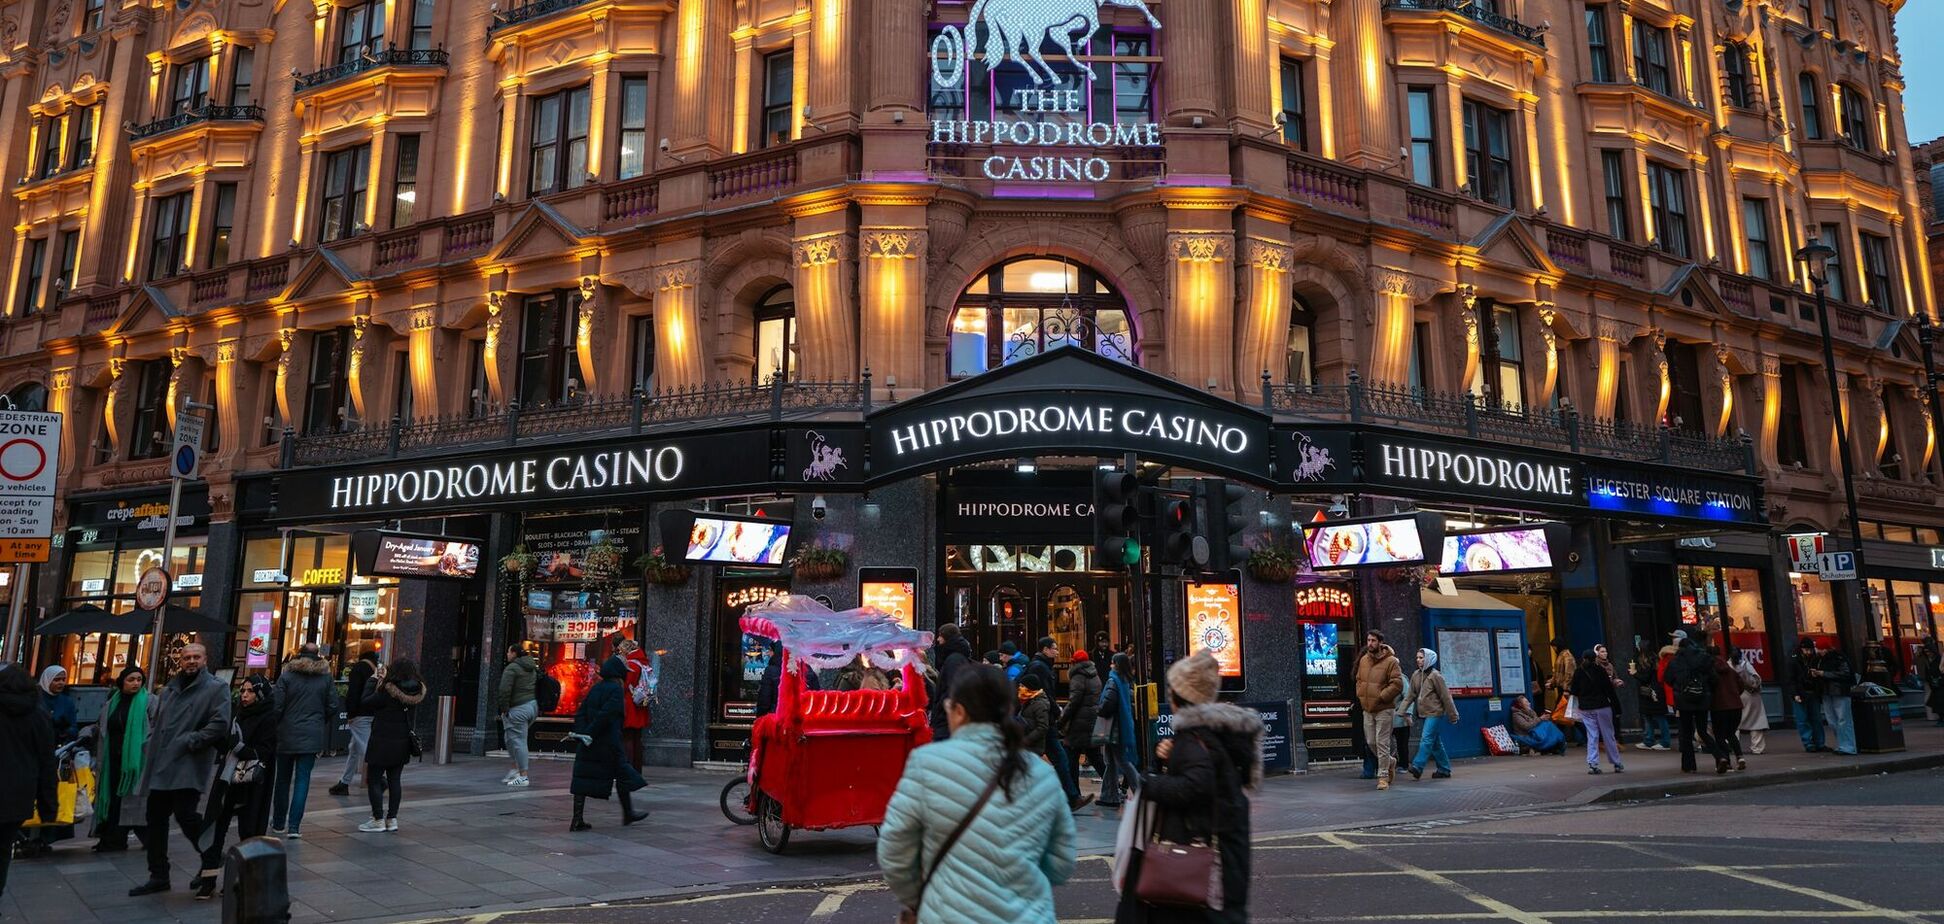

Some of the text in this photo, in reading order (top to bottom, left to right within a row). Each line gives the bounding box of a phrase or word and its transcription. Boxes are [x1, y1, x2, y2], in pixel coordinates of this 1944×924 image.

[1014, 88, 1080, 112] THE
[930, 119, 1162, 146] HIPPODROME
[983, 155, 1110, 181] CASINO
[0, 423, 47, 436] ZONE
[891, 406, 1248, 455] HIPPODROME CASINO
[179, 432, 198, 445] ZONE
[331, 446, 684, 508] HIPPODROME CASINO
[1380, 444, 1573, 496] HIPPODROME
[7, 483, 47, 491] vehicles
[1589, 477, 1751, 510] LEICESTER SQUARE STATION
[958, 502, 1071, 517] HIPPODROME
[19, 517, 39, 525] Sun
[7, 526, 18, 534] 10
[553, 531, 584, 540] BLACKJACK
[619, 527, 640, 535] STEAKS
[25, 543, 42, 551] any
[385, 541, 414, 553] Dry-Aged
[537, 541, 553, 549] SLOTS
[1837, 554, 1850, 570] P
[303, 568, 342, 585] COFFEE
[1297, 587, 1351, 606] CASINO
[1740, 648, 1764, 664] KFC
